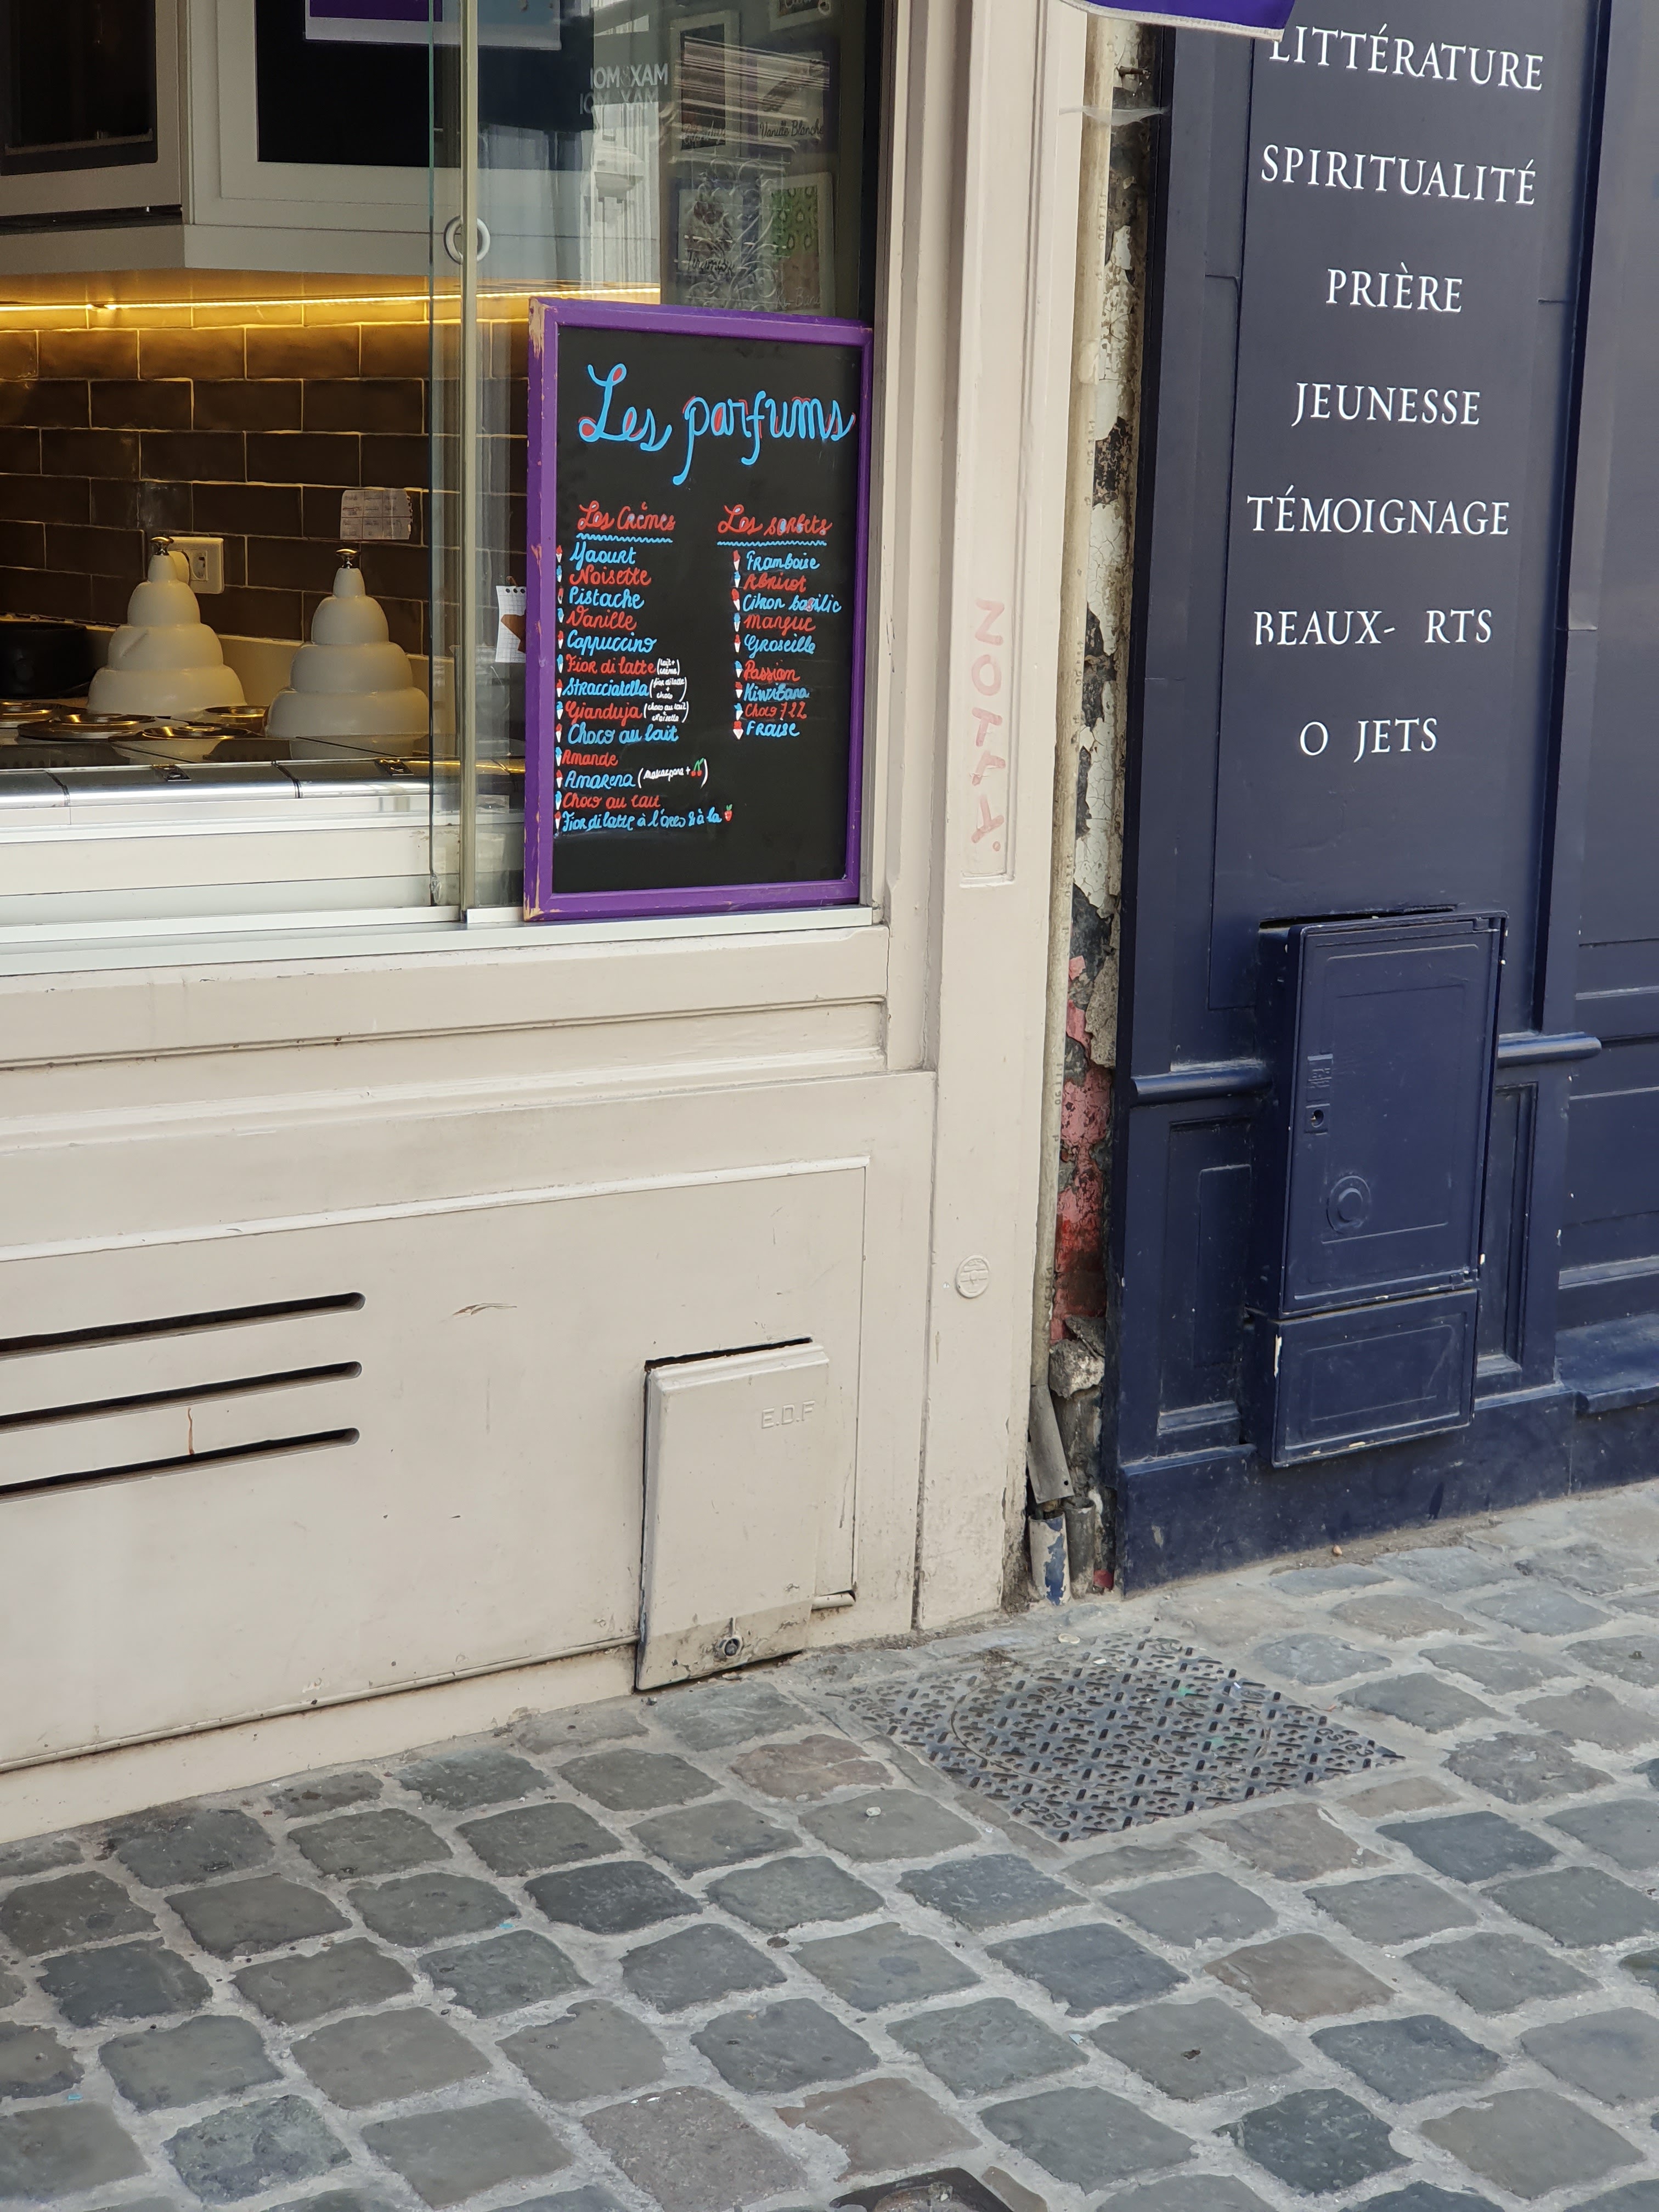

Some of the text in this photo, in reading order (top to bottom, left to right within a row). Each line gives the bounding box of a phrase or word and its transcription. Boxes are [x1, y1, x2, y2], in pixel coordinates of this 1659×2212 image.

[1269, 24, 1543, 91] LITTÉRATURE
[1261, 144, 1536, 205] SPIRITUALITÉ
[1326, 262, 1463, 314] PRIÈRE
[1291, 382, 1481, 427] JEUNESSE
[578, 363, 856, 485] Les parfums
[578, 500, 614, 531] Les
[717, 504, 763, 535] Les
[1247, 485, 1510, 535] TÉMOIGNAGE
[569, 541, 636, 571] Yaourt
[746, 550, 820, 571] Framboise
[569, 564, 652, 585] Noisette
[569, 586, 645, 609] Pistache
[566, 605, 637, 630] Vanille
[1254, 610, 1396, 646] BEAUX-
[567, 629, 657, 656] Cappuccino
[744, 633, 816, 658] Groseille
[566, 653, 657, 675] Fior di latte
[562, 677, 649, 697] Stracciatella
[565, 700, 643, 727] Gianduja
[568, 721, 679, 744] Choco au lait
[562, 749, 618, 766] Amande
[564, 770, 636, 789] Amarena
[562, 792, 602, 809] Choco
[606, 796, 628, 809] au
